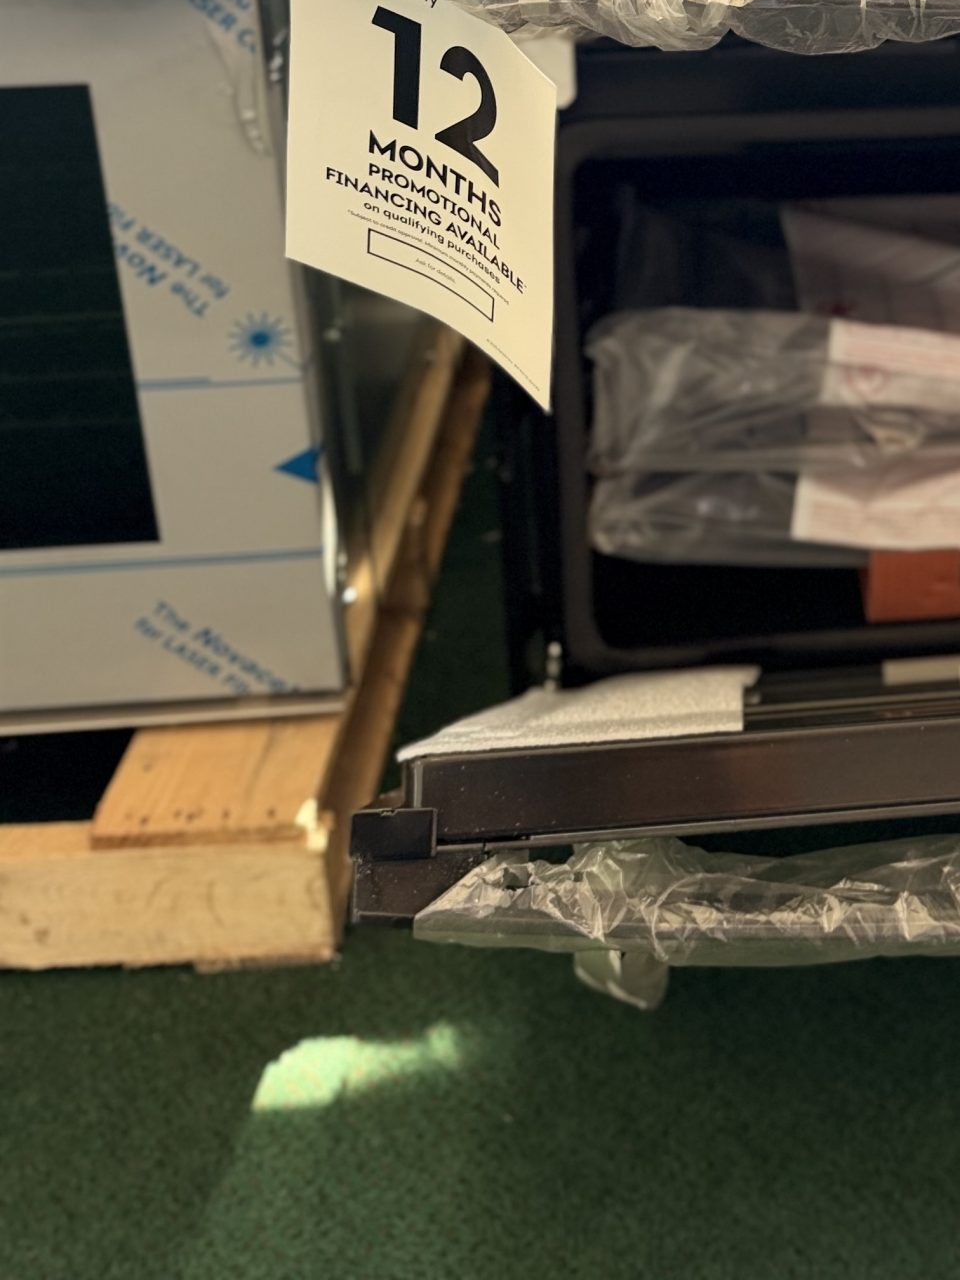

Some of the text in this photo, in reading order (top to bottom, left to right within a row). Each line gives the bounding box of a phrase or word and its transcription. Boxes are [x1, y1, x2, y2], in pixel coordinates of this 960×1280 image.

[371, 5, 500, 189] 12
[326, 166, 442, 226] FINANCING
[368, 129, 502, 227] MONTHS
[368, 163, 501, 250] PROMOTIONAL
[363, 201, 501, 285] on qualifying purchases
